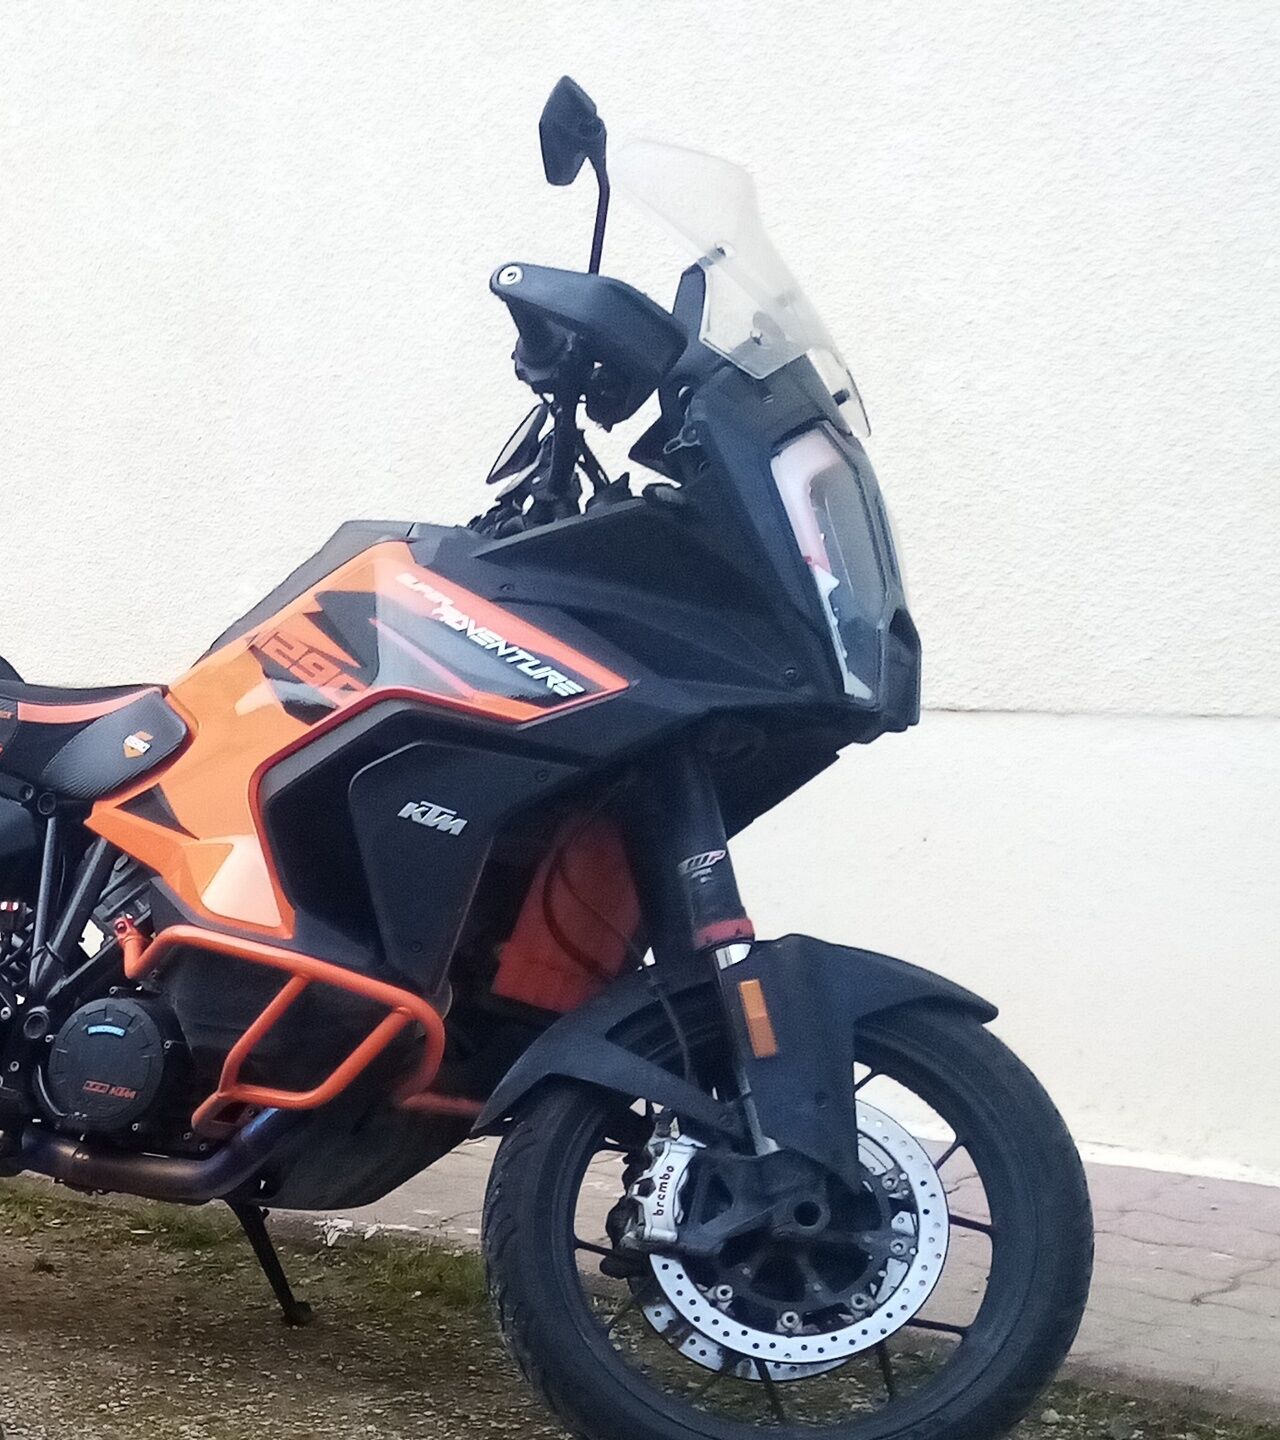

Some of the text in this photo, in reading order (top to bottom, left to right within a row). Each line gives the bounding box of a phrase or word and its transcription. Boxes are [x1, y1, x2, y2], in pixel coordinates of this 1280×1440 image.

[432, 602, 586, 697] ADVENTURE
[397, 800, 468, 836] KTM
[652, 1165, 675, 1217] brembo
